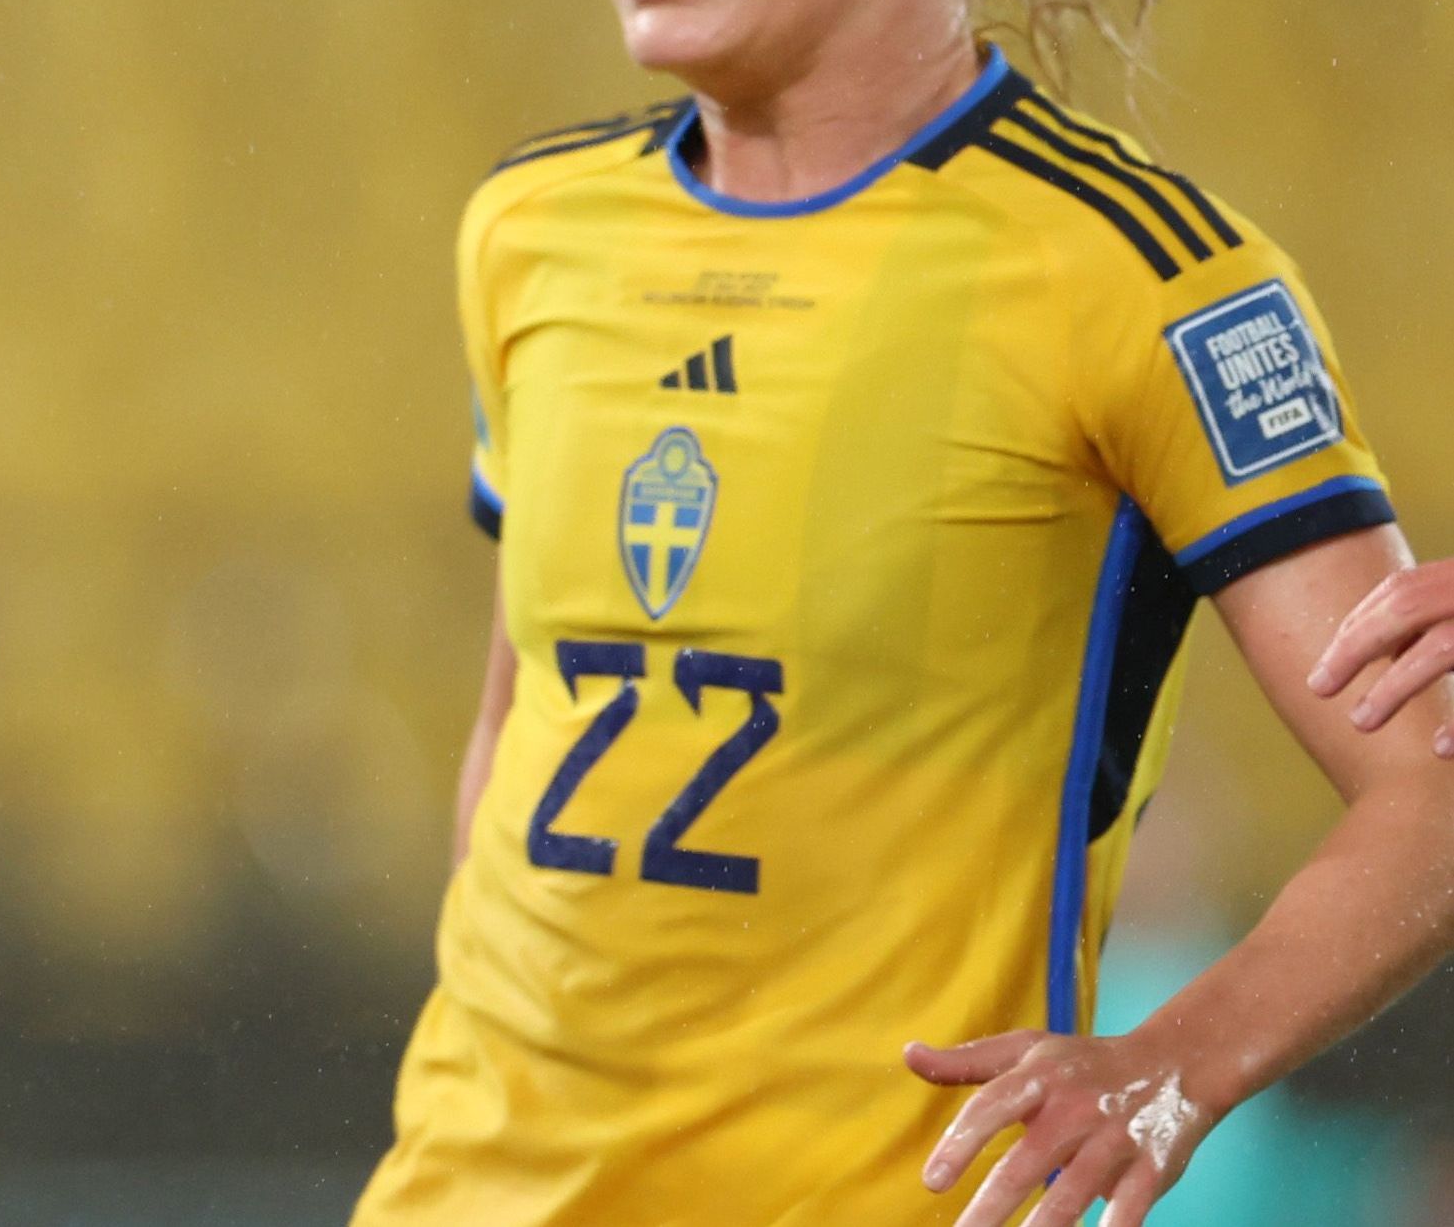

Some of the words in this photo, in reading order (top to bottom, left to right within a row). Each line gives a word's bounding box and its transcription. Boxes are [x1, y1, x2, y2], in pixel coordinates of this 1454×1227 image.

[1205, 310, 1288, 361] FOOTBALL
[1216, 332, 1300, 390] UNITES
[1268, 407, 1304, 429] FIFA
[527, 639, 785, 895] 22
